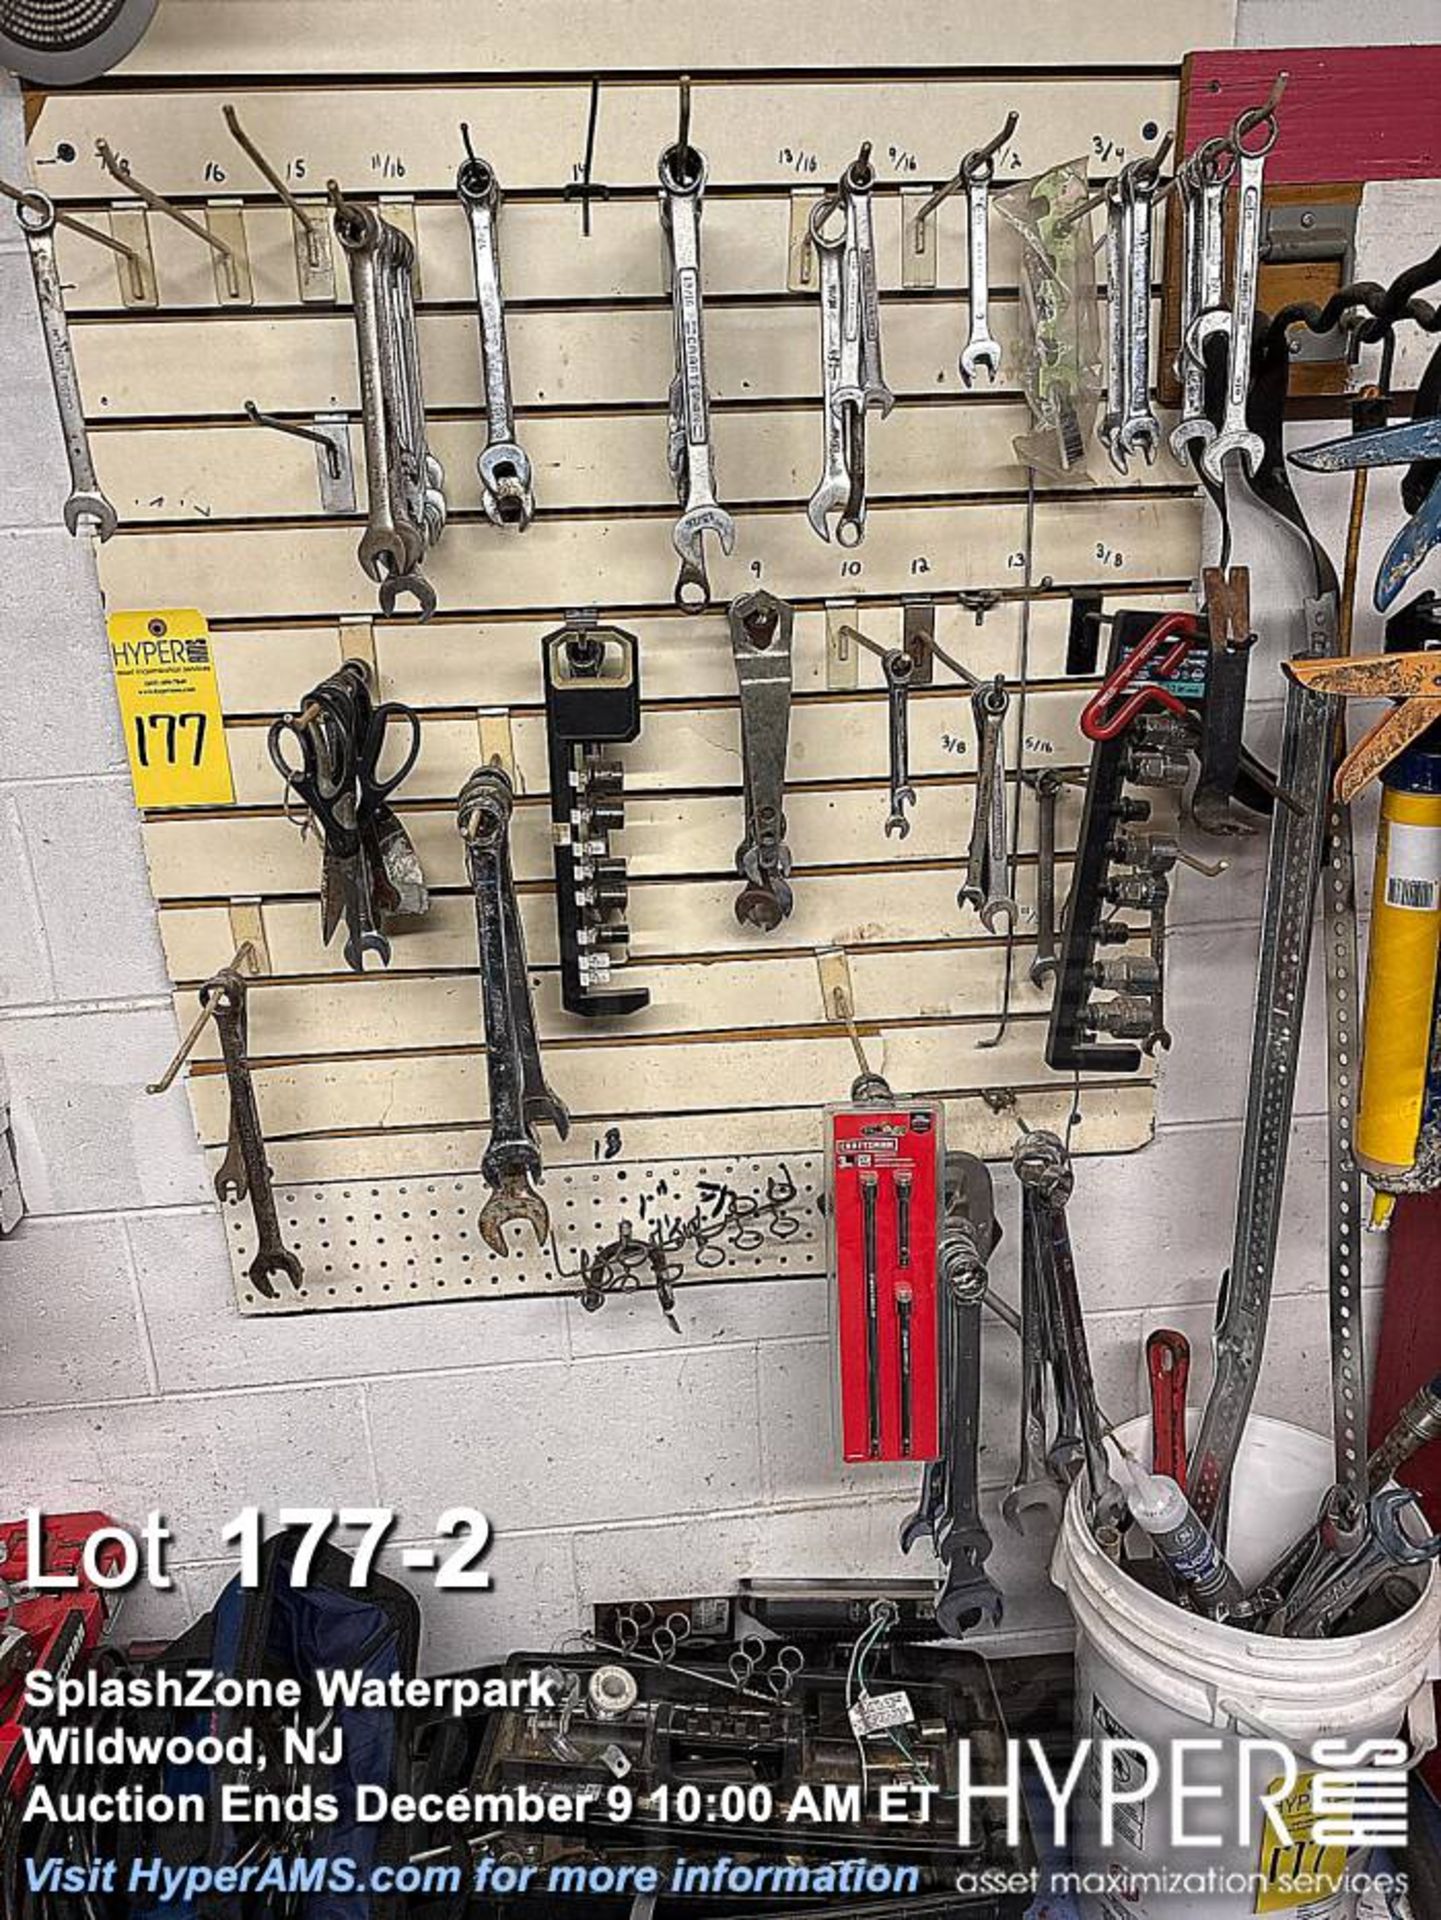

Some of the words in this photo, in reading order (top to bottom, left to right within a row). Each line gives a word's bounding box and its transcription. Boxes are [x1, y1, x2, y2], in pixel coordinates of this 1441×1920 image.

[778, 148, 818, 172] 13/16
[888, 146, 917, 172] 9/16
[998, 147, 1022, 169] /2
[1092, 135, 1125, 162] 3/4
[205, 162, 226, 182] 16
[286, 158, 306, 181] 15
[371, 153, 406, 178] 11/16
[911, 557, 930, 575] 12
[1008, 552, 1025, 569] 13
[1096, 542, 1123, 568] 3/8
[751, 560, 762, 578] 9
[841, 561, 862, 577] 10
[112, 639, 186, 666] HYPER
[135, 712, 207, 767] 177
[941, 734, 967, 755] 3/8
